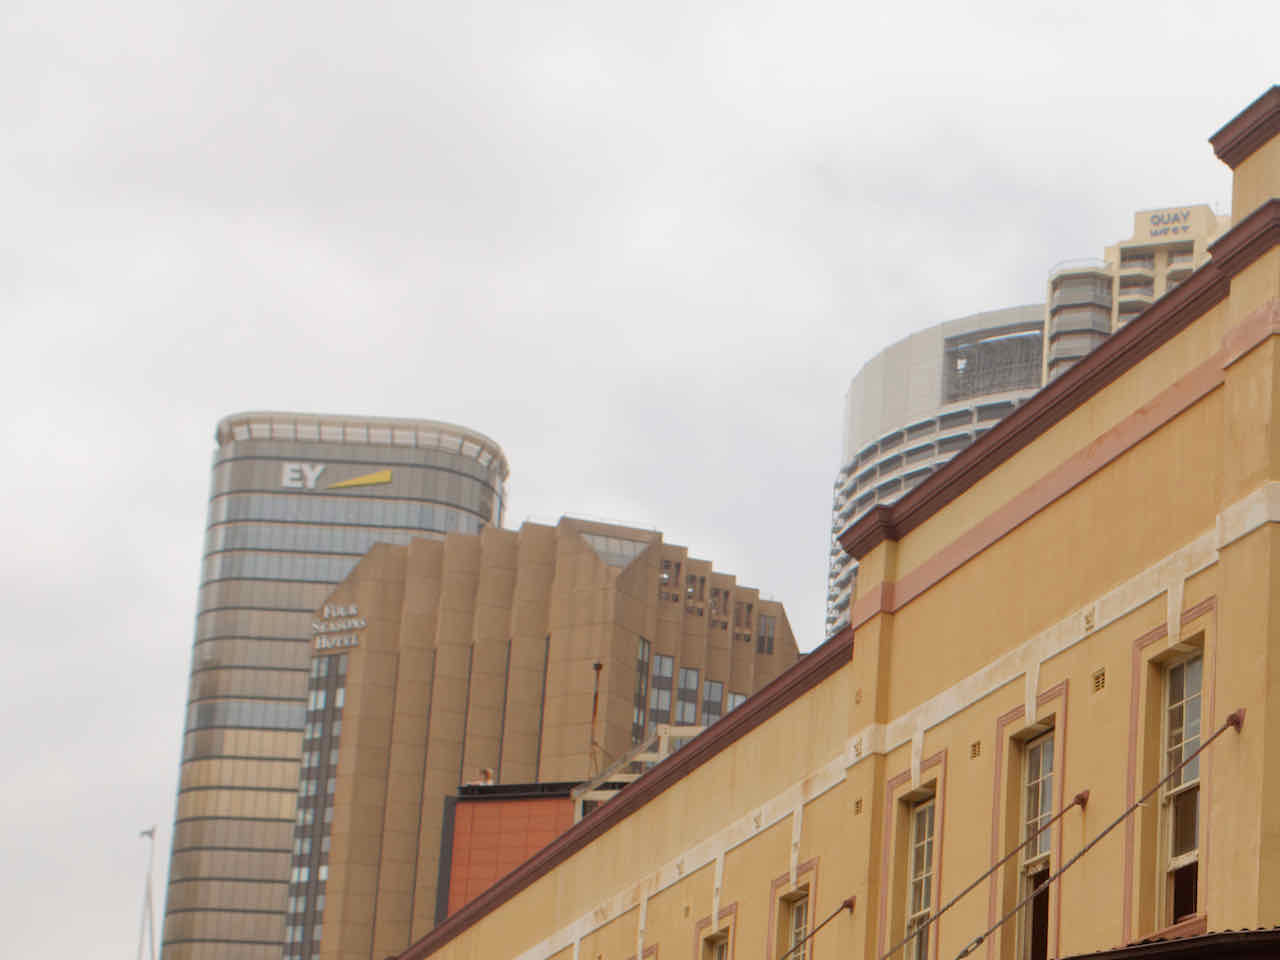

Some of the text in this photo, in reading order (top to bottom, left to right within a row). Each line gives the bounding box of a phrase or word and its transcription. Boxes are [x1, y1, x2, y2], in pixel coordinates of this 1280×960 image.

[1150, 210, 1190, 226] QUAY
[281, 464, 325, 488] EY
[314, 633, 360, 649] HOTEL
